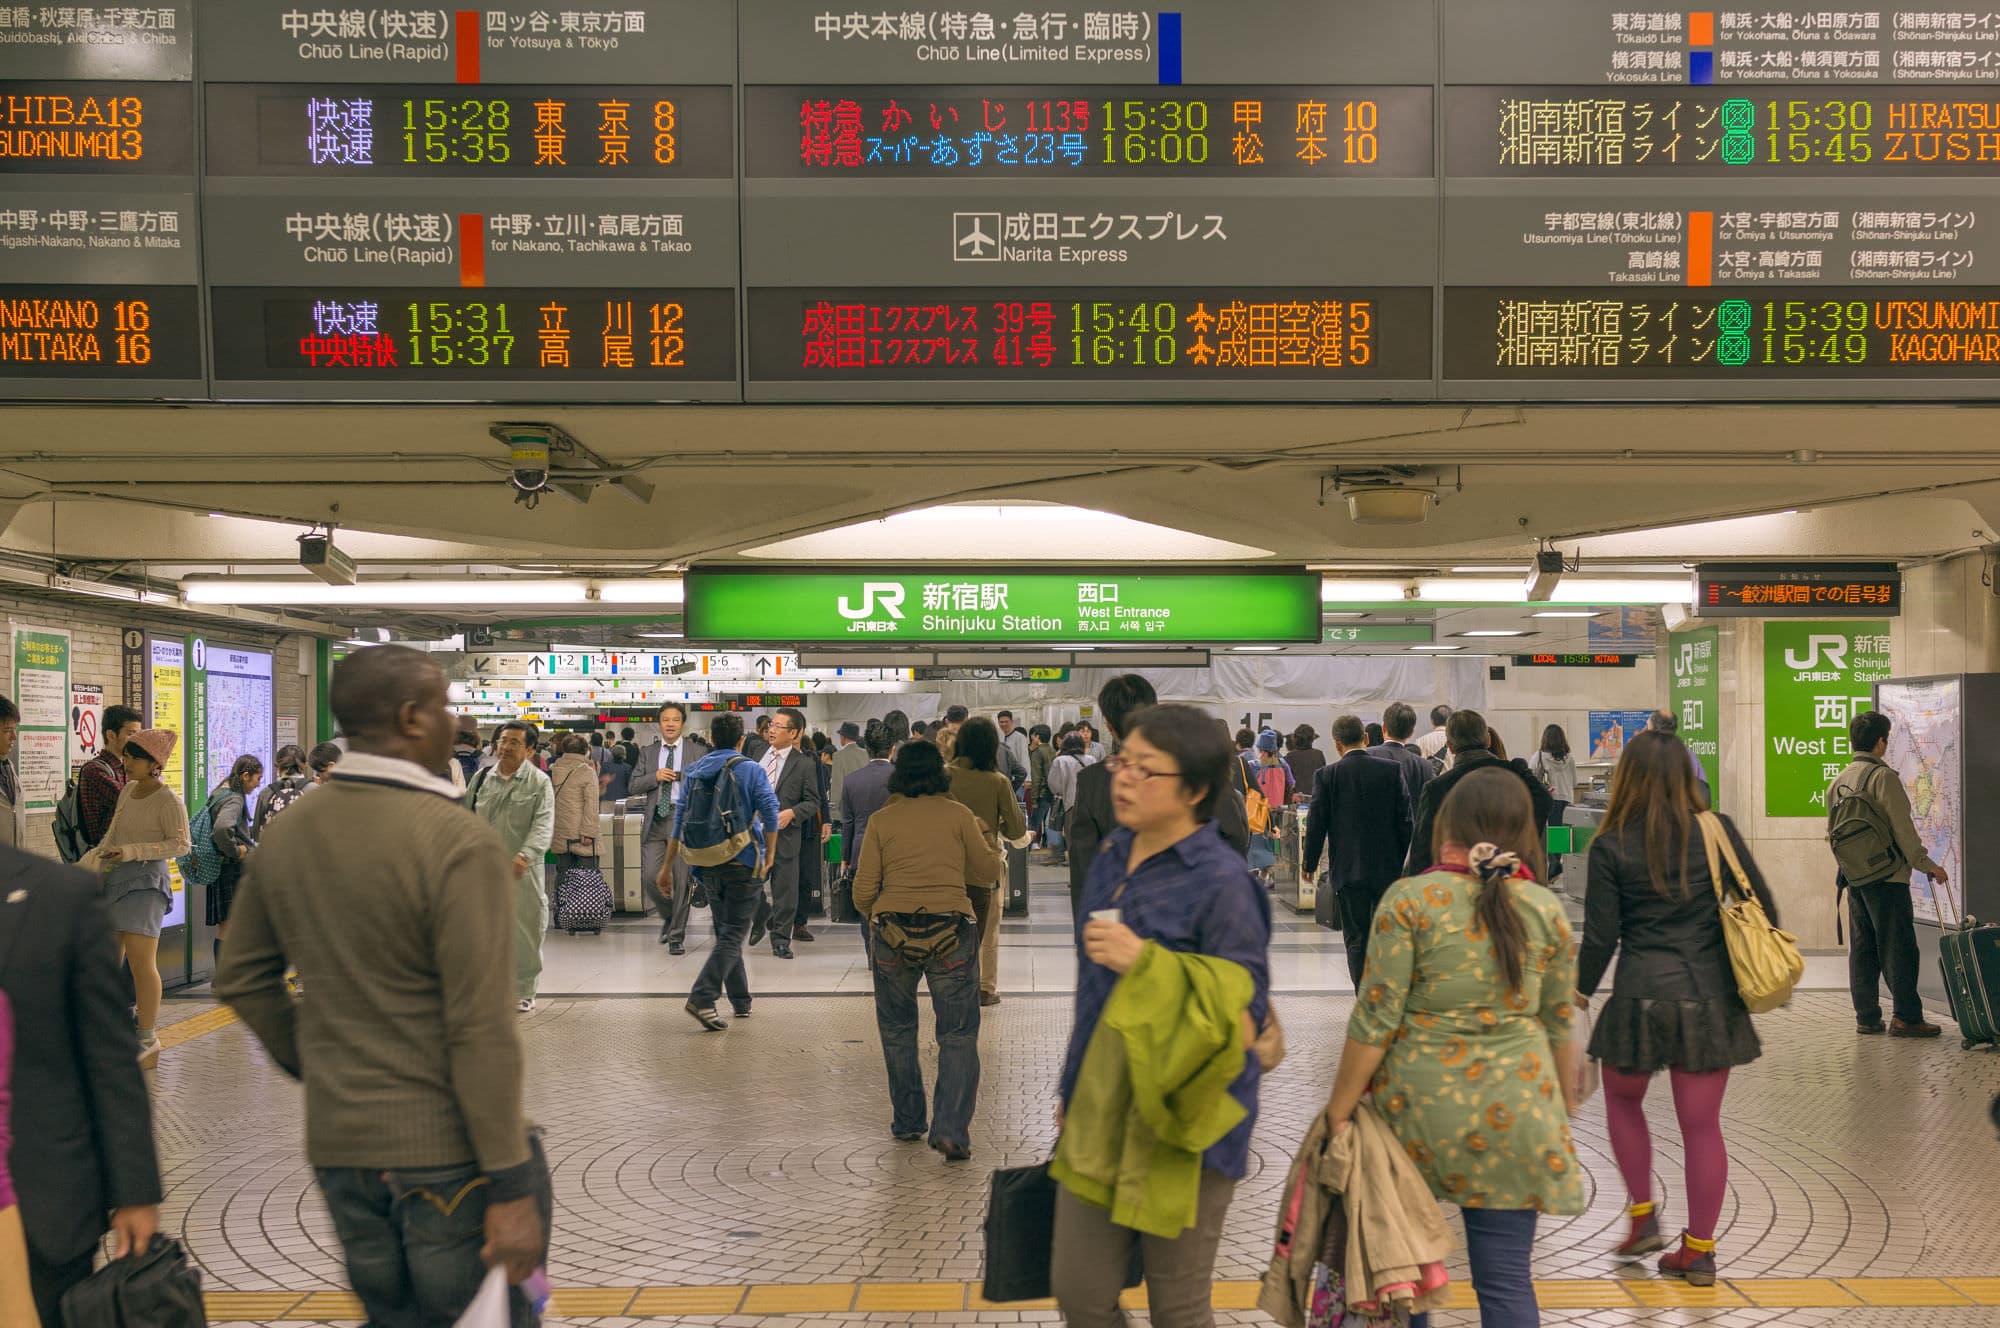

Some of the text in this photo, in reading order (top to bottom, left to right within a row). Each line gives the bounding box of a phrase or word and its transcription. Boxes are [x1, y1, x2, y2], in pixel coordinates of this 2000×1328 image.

[281, 9, 450, 39] 中央線(快速)
[486, 10, 646, 33] 四ッ谷・東京方面
[814, 11, 1152, 41] 中央本線(特急・急行・臨時)
[1611, 12, 1682, 31] 東海道線
[1720, 11, 1880, 29] 横浜・大船・小田原方面
[142, 32, 176, 45] Chiba
[509, 35, 618, 51] Yotsuya Tōkyō
[1615, 33, 1682, 44] Tōkaidō Line
[1737, 31, 1789, 41] Yokohama,
[1975, 30, 1999, 42] Line)
[299, 42, 449, 62] Chūō Line(Rapid)
[917, 45, 960, 61] Chūō
[1075, 44, 1152, 64] Express)
[1612, 51, 1682, 69] 横須賀線
[1720, 50, 1880, 68] 横浜・大船・横須賀方面
[1606, 72, 1682, 82] Yokosuka Line
[1737, 69, 1789, 80] Yokohama,
[1833, 69, 1879, 79] Yokosuka
[1975, 69, 1999, 80] Line)
[0, 96, 142, 127] HIBA 13
[308, 98, 675, 134] 快速 15:28 東京 8
[800, 99, 1377, 133] 特急 かいじ 113号 15:30 甲府 10
[1499, 99, 2000, 132] 湘南新宿ライン 15:30 HIRATSU
[107, 130, 142, 160] 13
[308, 131, 675, 165] 快速 15:35 東京 8
[800, 132, 864, 167] 特急
[1102, 133, 1208, 163] 16:00
[1232, 131, 1328, 166] 松本
[1343, 133, 1377, 163] 10
[1499, 132, 2000, 165] 湘南新宿ライン 15:45 ZUSH
[286, 212, 452, 243] 中央線(快速)
[490, 213, 683, 236] 中野・立川・高尾方面
[1003, 211, 1228, 241] 成田エクスプレス
[1544, 211, 1682, 231] 宇都宮線(東北線)
[1719, 212, 1840, 229] 大宮・宇都宮方面
[1852, 211, 1975, 230] (湘南新宿ライン)
[89, 236, 180, 248] Nakano Mitaka
[1523, 233, 1583, 245] Utsunomiya
[1655, 233, 1682, 244] Line)
[1779, 230, 1833, 241] Utsunomiya
[304, 246, 453, 266] Chūō Line(Rapid)
[512, 239, 692, 253] Nakano, Tachikawa Takao
[1003, 246, 1128, 265] Narita Express
[1628, 251, 1681, 269] 高崎線
[1719, 251, 1822, 268] 大宮・高崎方面
[1850, 250, 1974, 268] (湘南新宿ライン)
[1608, 271, 1681, 282] Takasaki Line
[1778, 269, 1820, 279] Takasaki
[0, 300, 150, 331] NAKANO 16
[313, 300, 684, 335] 快速 15:31 立川 12
[802, 300, 1370, 336] 成田エクスプレス 39号 15:40 成田空港 5
[1497, 300, 2000, 334] 湘南新宿ライン 15:39 UTSUNOMI
[1, 332, 151, 364] MITAKA 16
[300, 333, 685, 367] 中央特快 15:37 高尾 12
[802, 333, 1370, 368] 成田エクスプレス 41号 16:10 成田空港 5
[1497, 333, 2000, 366] 湘南新宿ライン 15:49 KAGOHAR
[838, 582, 906, 619] JR
[922, 582, 1009, 611] 新宿駅
[1078, 582, 1118, 603] 西口
[1078, 607, 1171, 618] West Entrance
[847, 621, 898, 632] JR東日本
[923, 615, 1062, 634] Shinjuku Station
[1674, 643, 1693, 677] JR
[1784, 634, 1848, 670] JR
[1794, 671, 1841, 682] JR東日本
[1682, 699, 1703, 730] 西口
[1773, 737, 1826, 755] West
